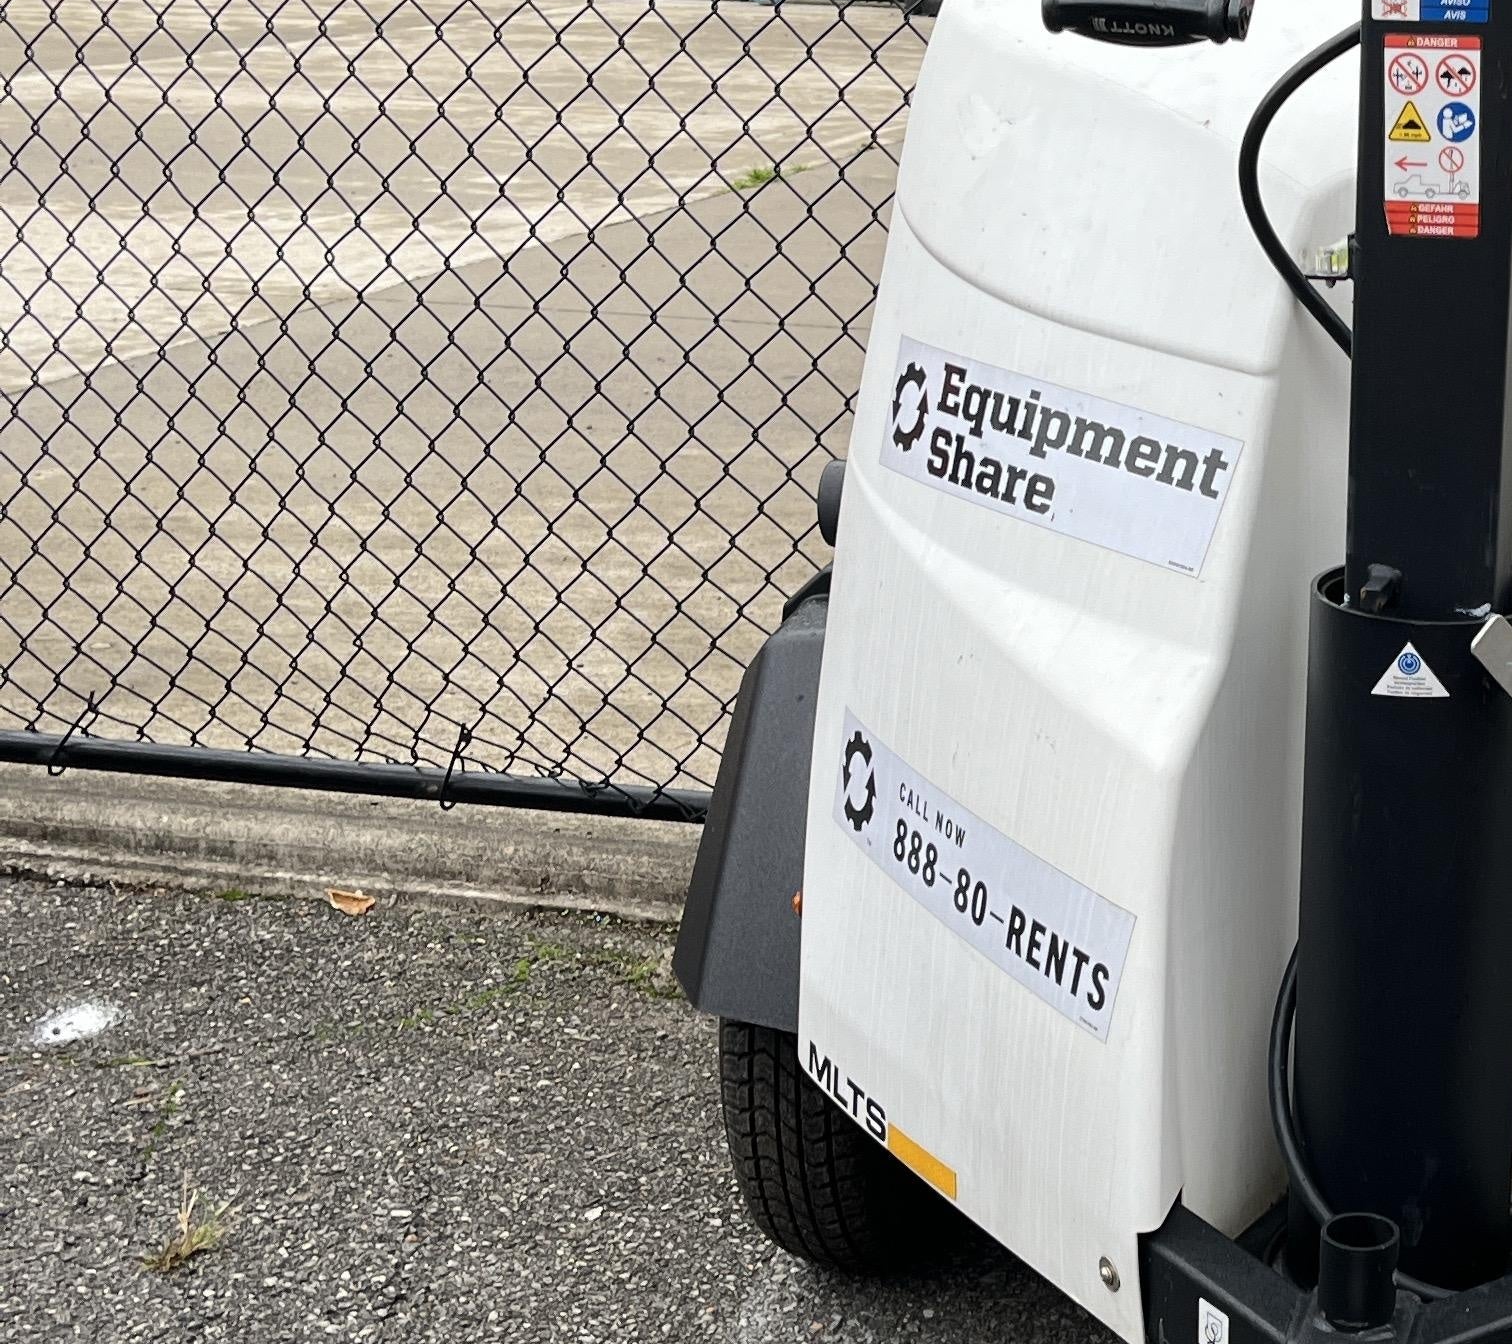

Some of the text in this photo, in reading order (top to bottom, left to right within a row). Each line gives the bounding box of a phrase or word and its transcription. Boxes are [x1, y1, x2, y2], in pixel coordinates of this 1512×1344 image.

[1443, 10, 1466, 21] AVIS
[1110, 17, 1175, 37] KNOTT
[1416, 37, 1458, 48] DANGER
[1418, 203, 1454, 213] GEFAHR
[1416, 215, 1455, 224] PELIGRO
[1417, 225, 1454, 235] DANGER
[936, 362, 1230, 500] Equipment
[926, 426, 1056, 515] Share
[900, 782, 966, 849] CALL NOW
[893, 817, 1110, 1012] 888-80-RENTS
[808, 1039, 886, 1143] MLTS
